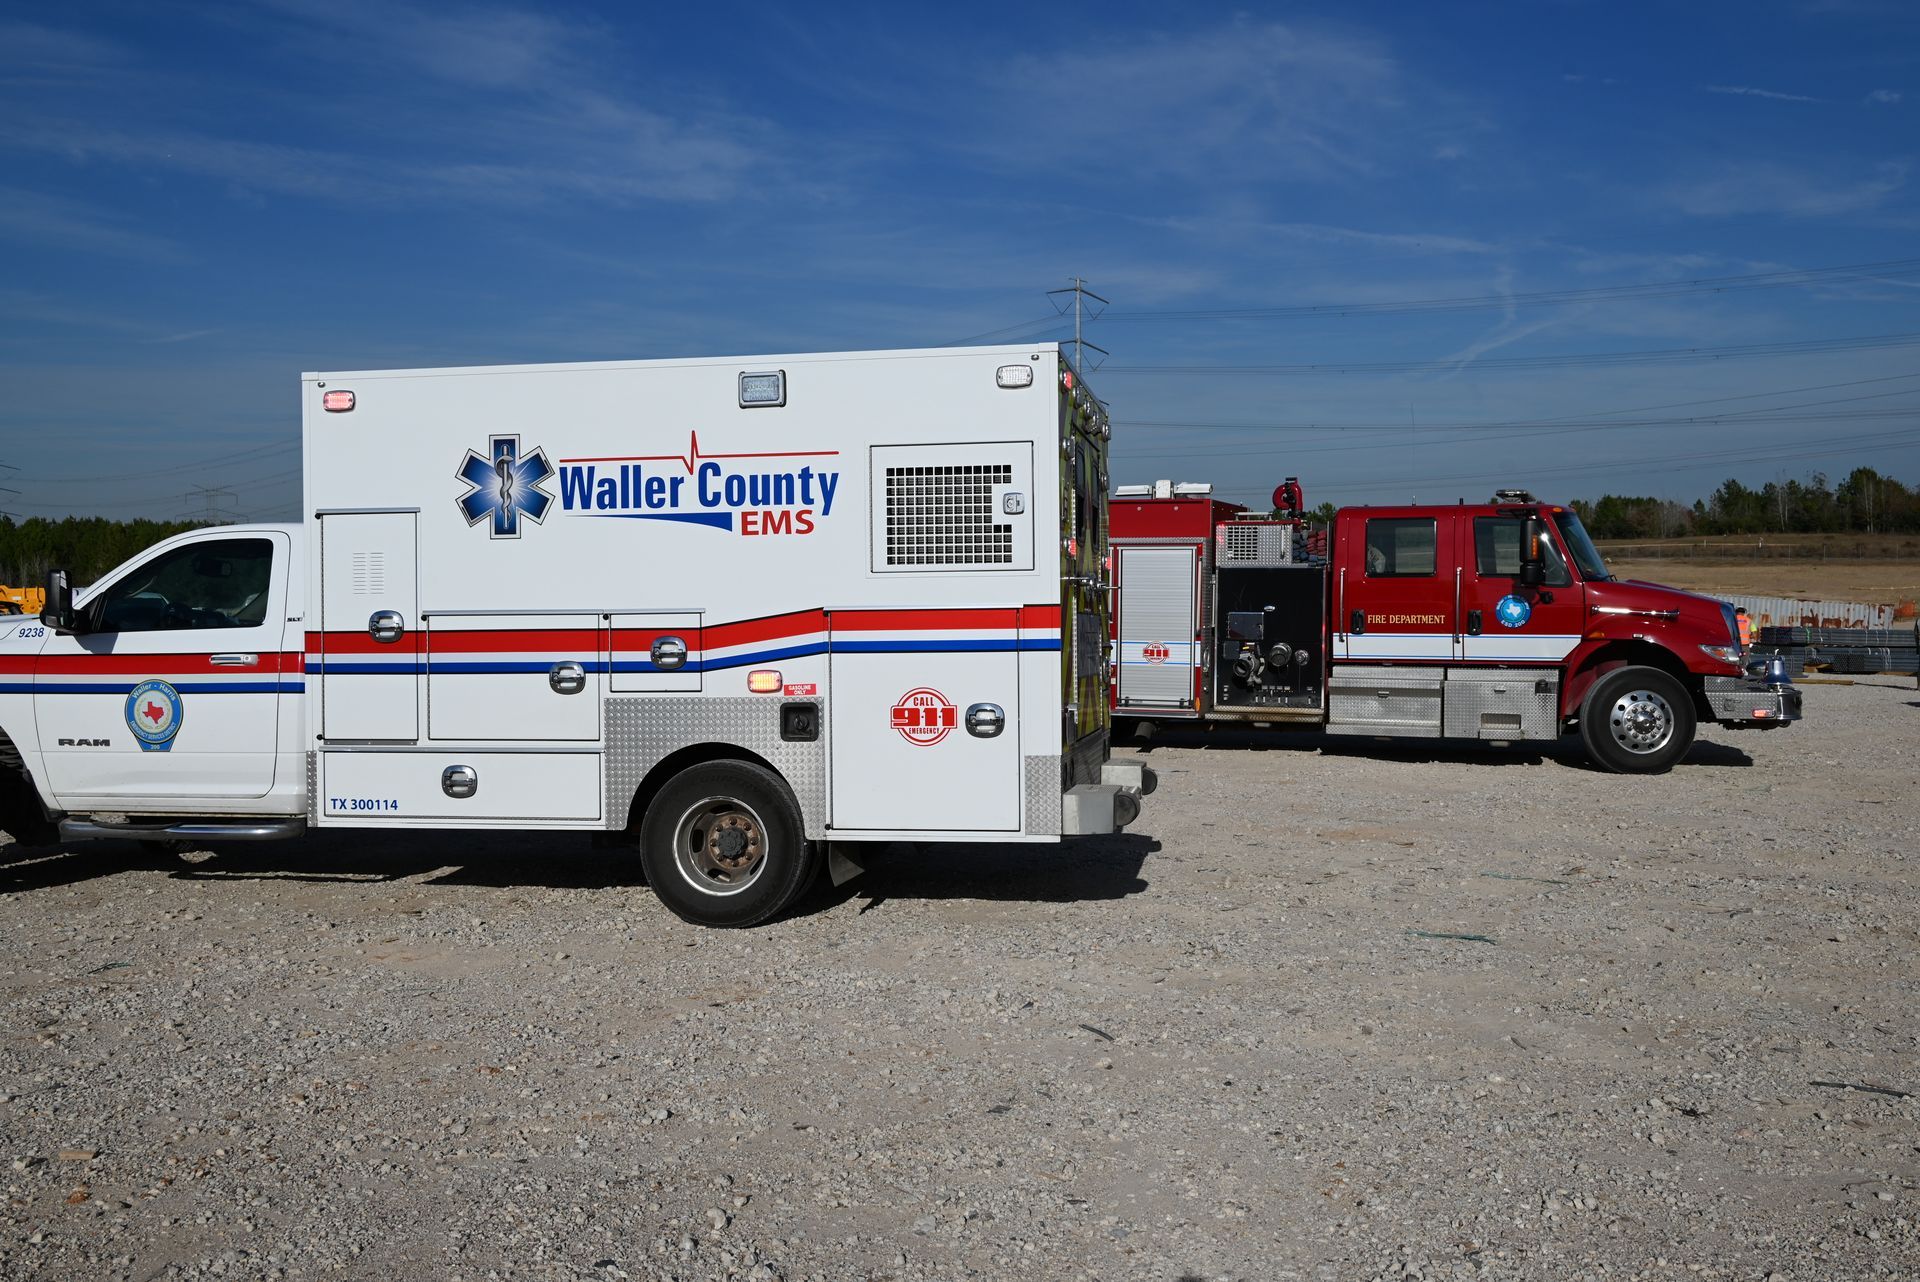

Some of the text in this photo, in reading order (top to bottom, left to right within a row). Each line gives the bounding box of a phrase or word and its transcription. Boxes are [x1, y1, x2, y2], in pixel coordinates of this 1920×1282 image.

[559, 461, 839, 516] Waller County
[741, 509, 815, 536] EMS
[1367, 614, 1446, 624] FIRE DEPARTMENT
[19, 627, 45, 638] 9238
[132, 683, 152, 699] Waller
[160, 683, 176, 701] Harris
[913, 697, 935, 706] CALL
[908, 727, 940, 735] EMERGENCY
[58, 738, 110, 747] RAM
[330, 798, 399, 811] TX 300114
